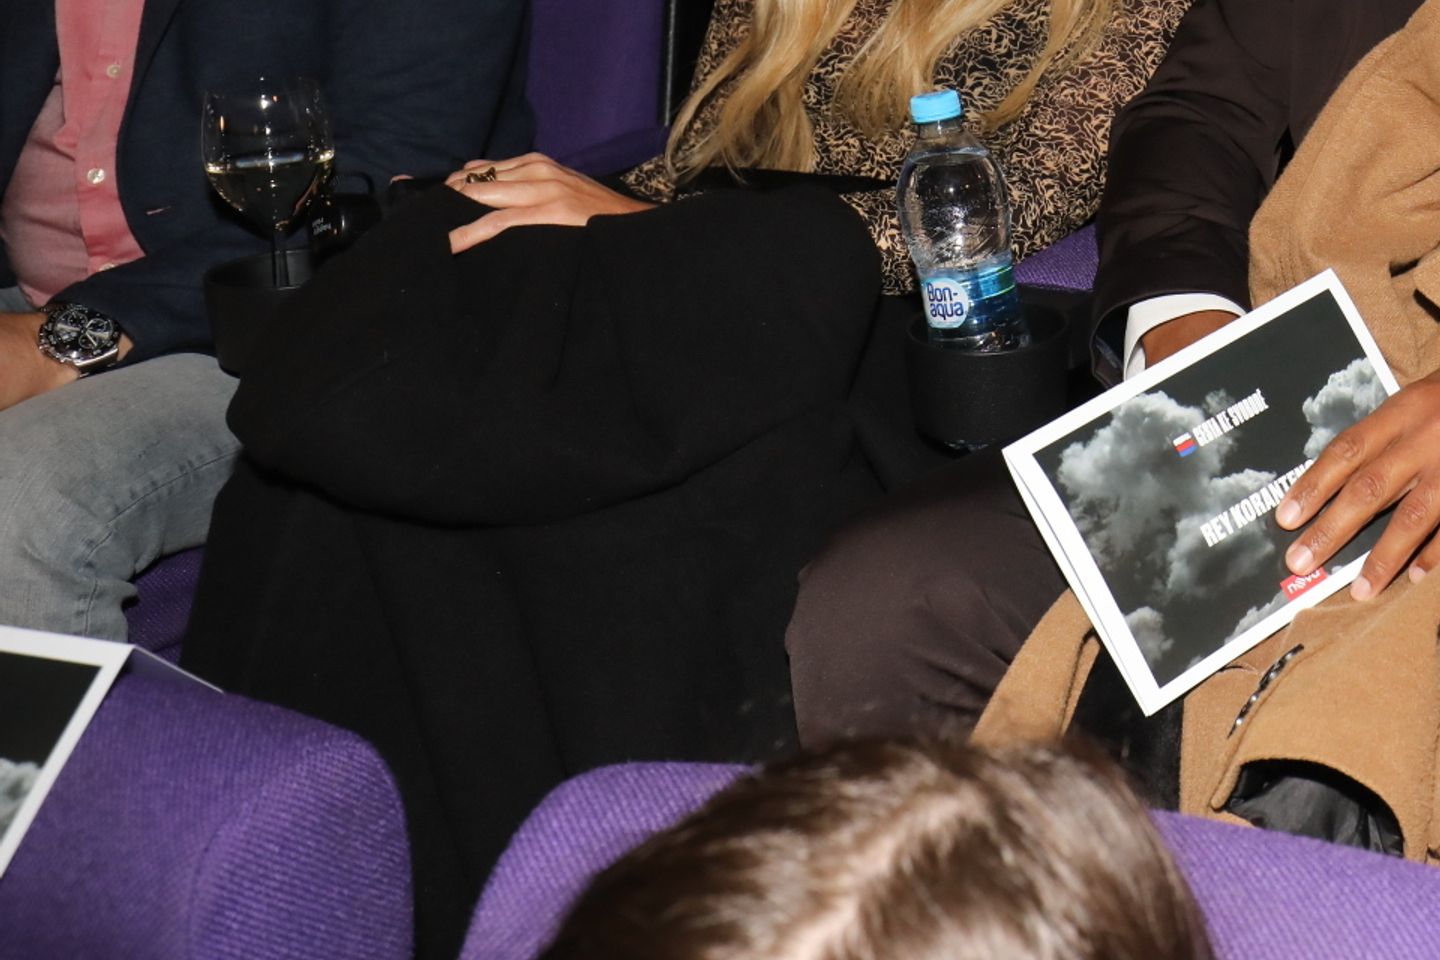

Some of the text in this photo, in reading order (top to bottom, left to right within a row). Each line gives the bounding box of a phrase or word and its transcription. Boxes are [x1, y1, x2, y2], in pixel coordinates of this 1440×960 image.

[927, 282, 959, 303] Bon-
[929, 301, 965, 321] aqua
[1215, 410, 1235, 434] KE
[1199, 458, 1316, 548] REY KORANTE
